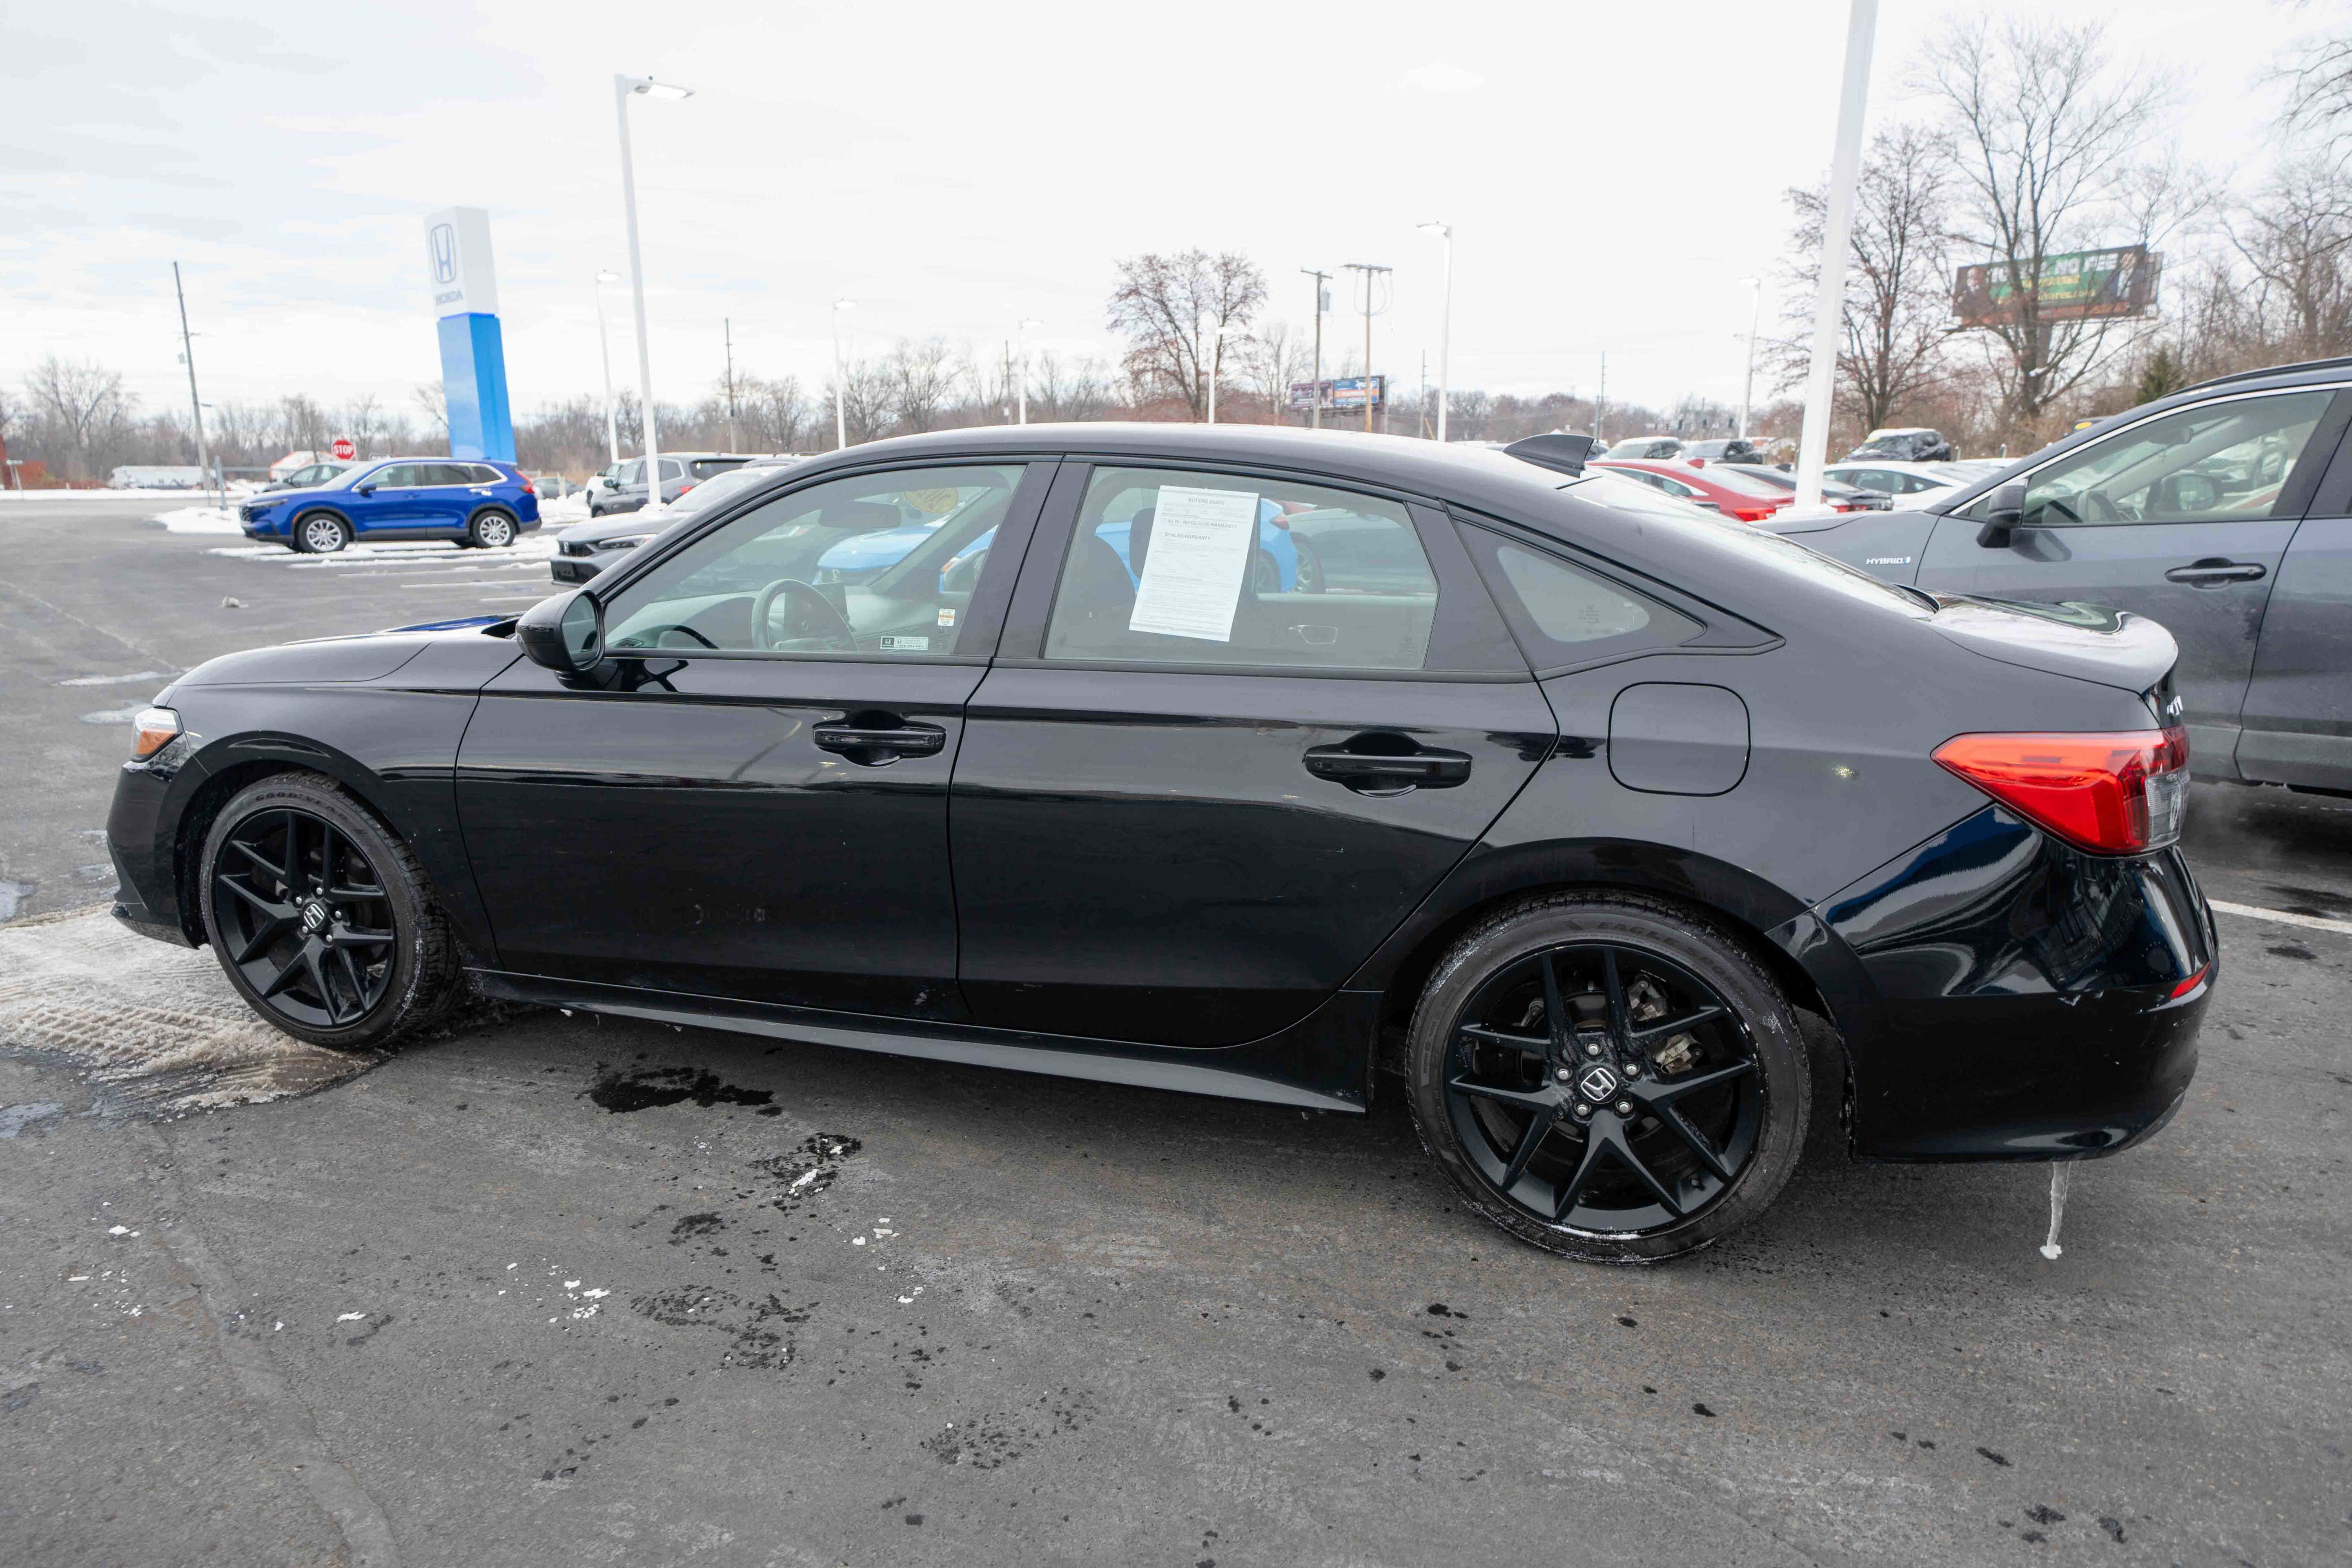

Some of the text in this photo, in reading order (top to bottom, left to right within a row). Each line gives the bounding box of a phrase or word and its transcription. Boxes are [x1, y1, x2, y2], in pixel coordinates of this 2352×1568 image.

[2083, 253, 2119, 272] FEE
[435, 290, 463, 305] HONDA
[333, 444, 353, 455] STOP
[1597, 921, 1679, 946] EAGLE
